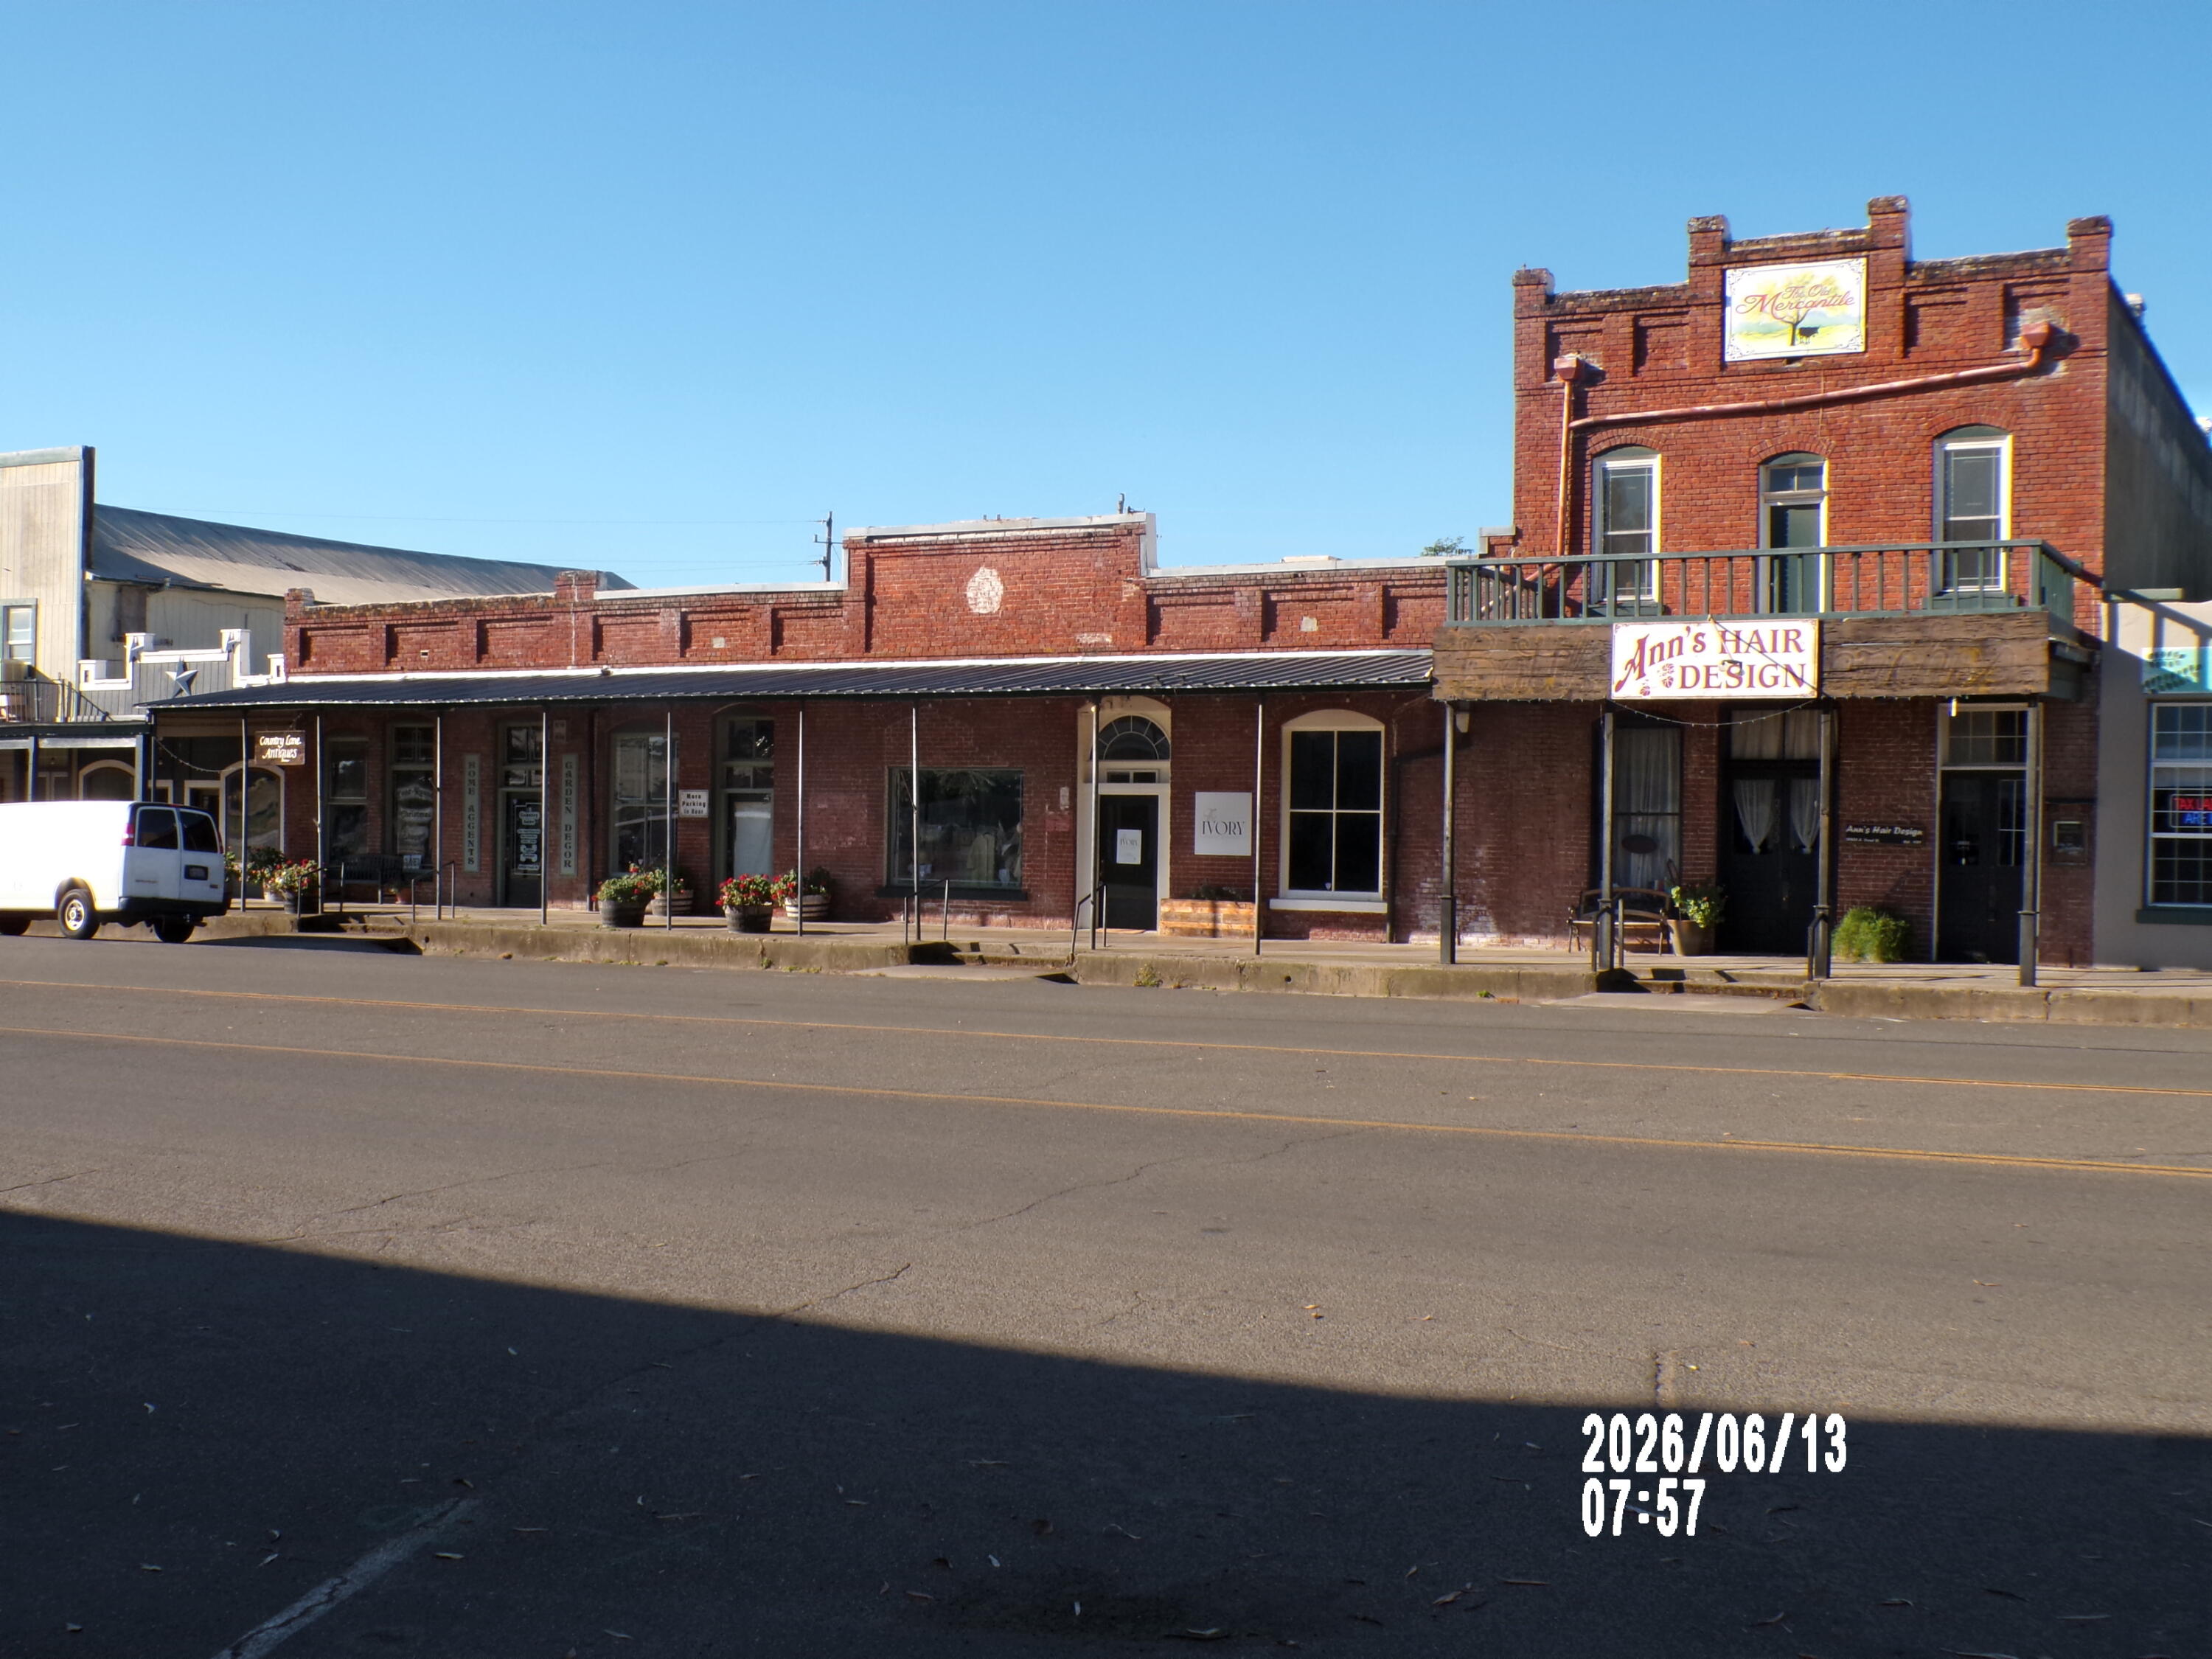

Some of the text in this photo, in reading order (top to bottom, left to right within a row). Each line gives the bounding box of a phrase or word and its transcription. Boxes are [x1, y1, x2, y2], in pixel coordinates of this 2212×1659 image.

[1781, 284, 1831, 299] The Old
[1736, 291, 1855, 320] Mercantile
[1615, 626, 1706, 692] Ann's
[1718, 629, 1806, 654] HAIR
[1678, 663, 1807, 689] DESIGN
[260, 734, 302, 748] Country Lane
[262, 748, 298, 762] Antiques
[467, 762, 476, 796] HOME
[564, 761, 573, 814] GARDEN
[2174, 798, 2195, 810] TAX
[2185, 812, 2207, 824] ARE
[1202, 821, 1245, 835] IVORY
[1846, 825, 1924, 837] Ann's Hair Design
